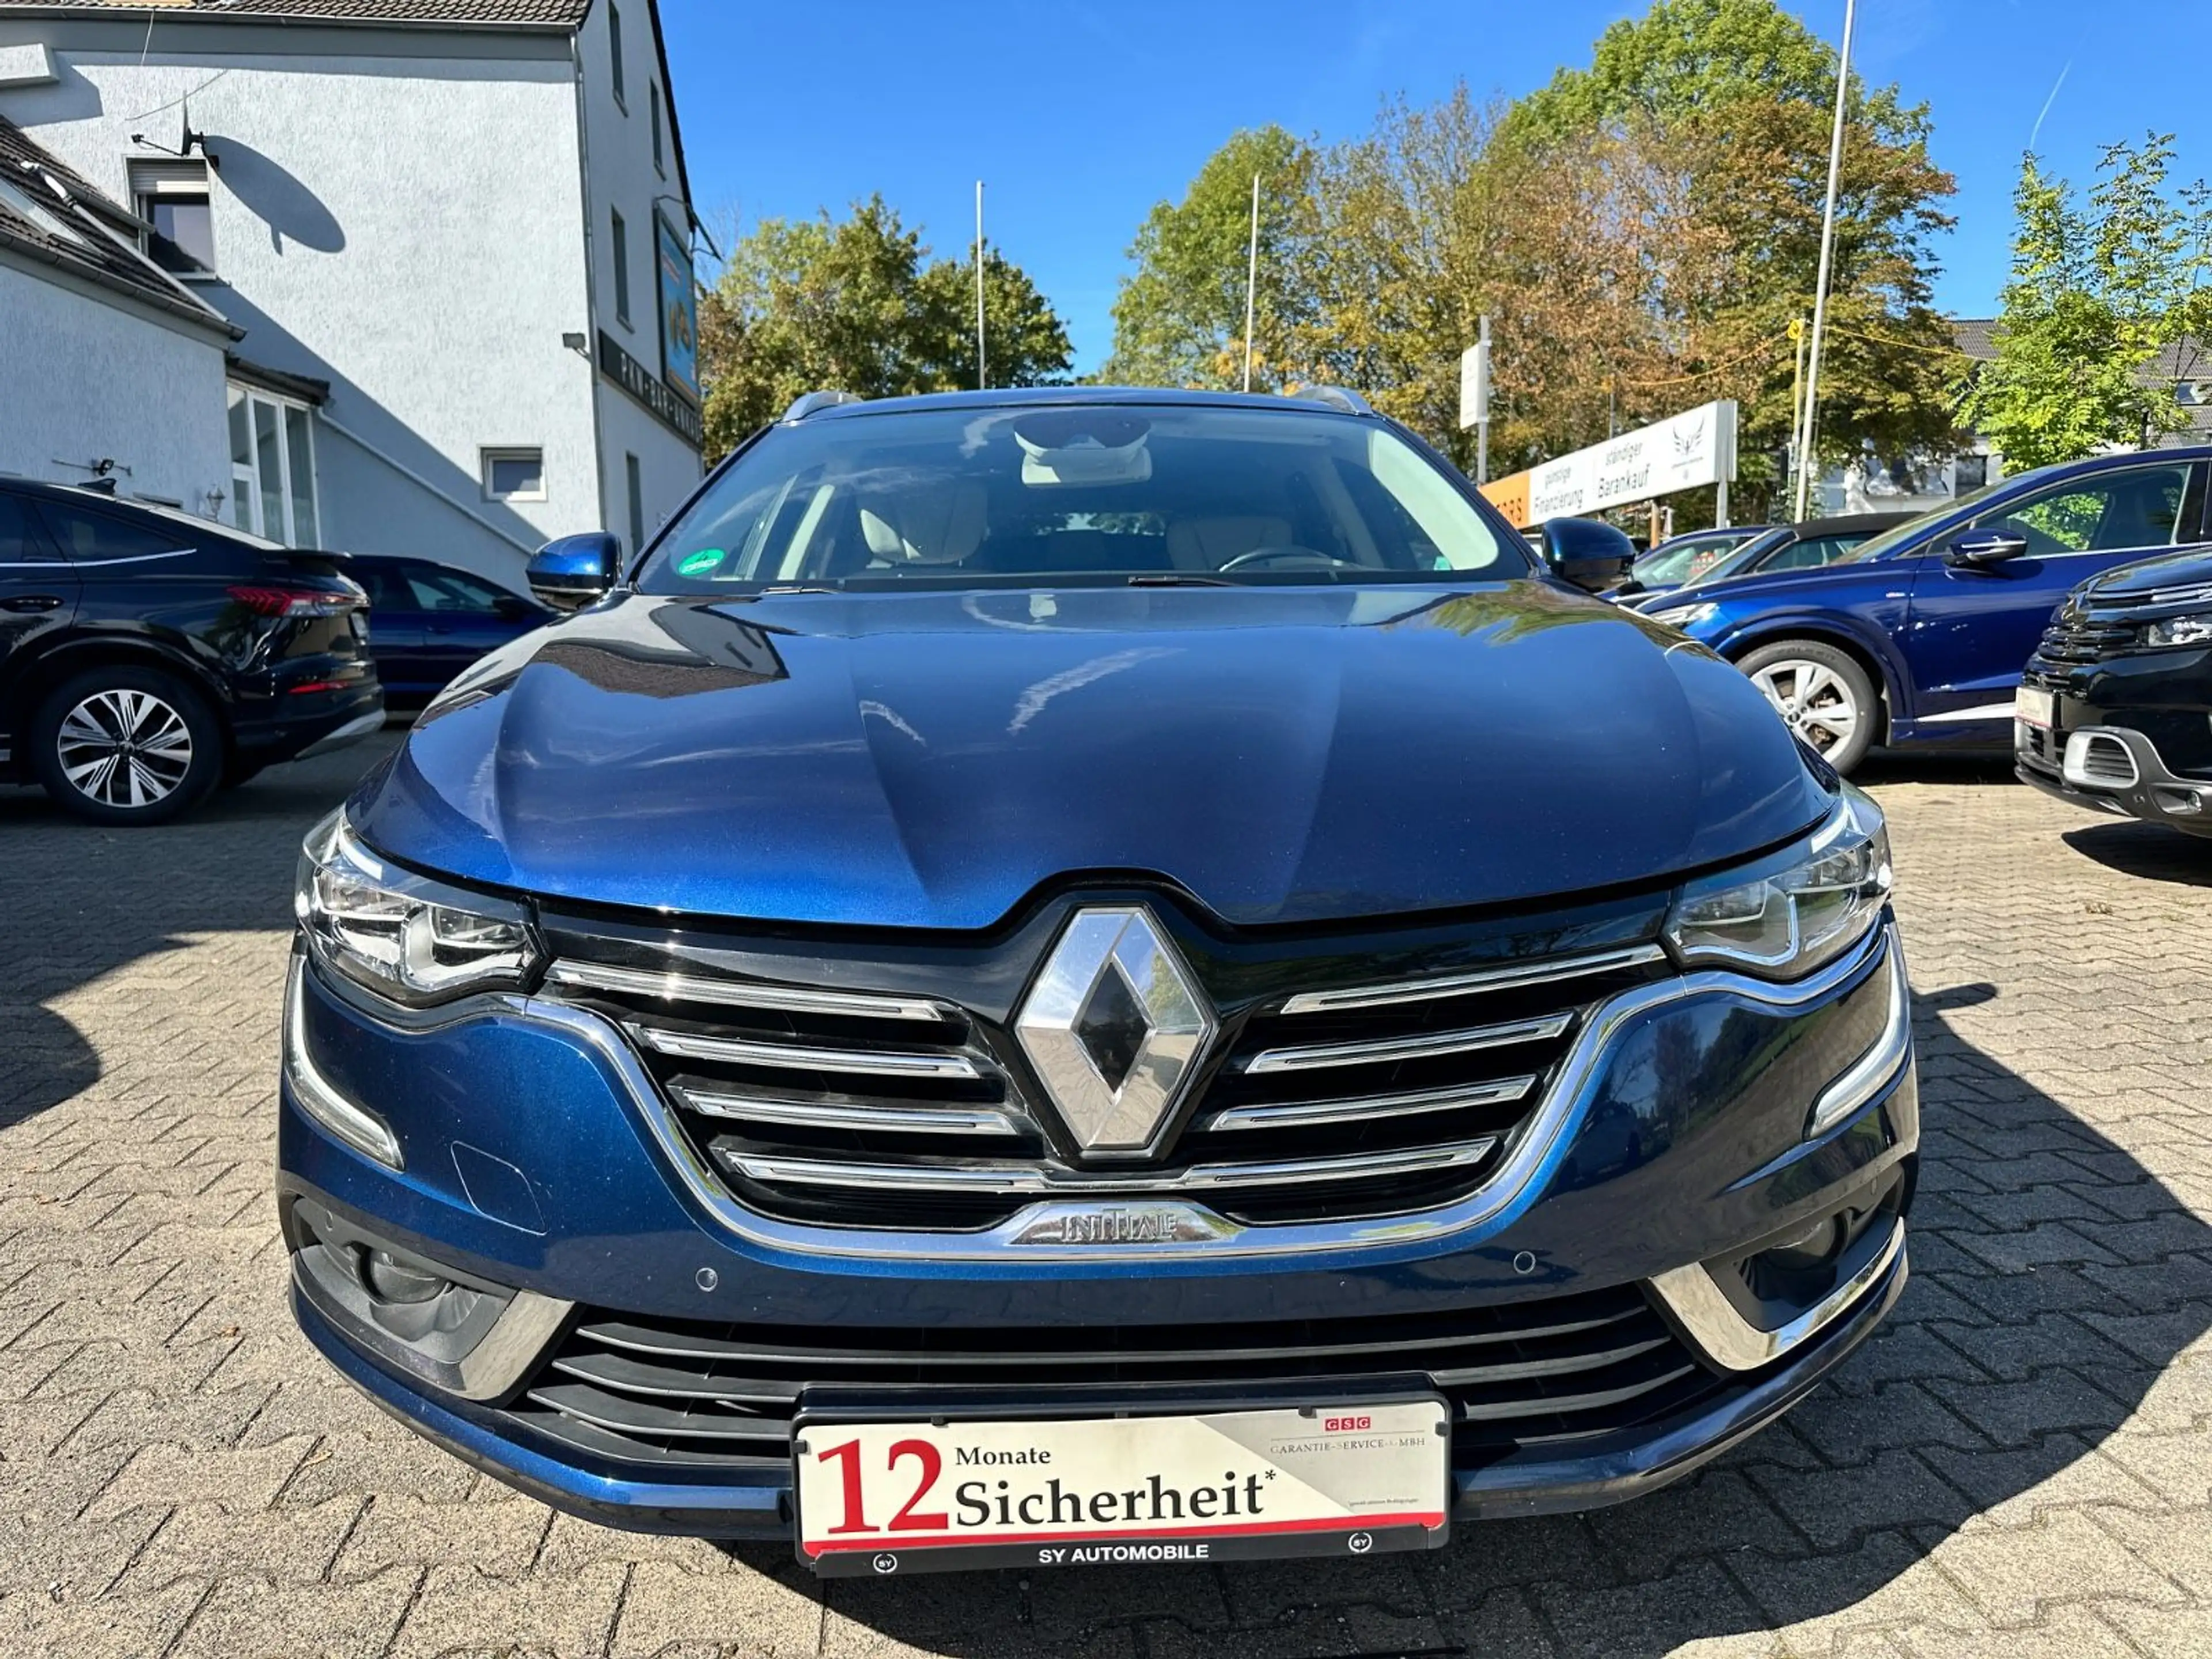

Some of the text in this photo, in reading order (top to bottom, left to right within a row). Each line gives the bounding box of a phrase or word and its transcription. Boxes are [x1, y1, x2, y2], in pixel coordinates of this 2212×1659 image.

[1597, 463, 1652, 499] Barankauf
[1535, 489, 1584, 514] Finanzierung
[1061, 1208, 1177, 1242] INITIALE
[1325, 1416, 1371, 1431] GSG
[955, 1446, 1051, 1465] Monate
[818, 1438, 949, 1534] 12
[1039, 1544, 1209, 1563] SY AUTOMOBILE
